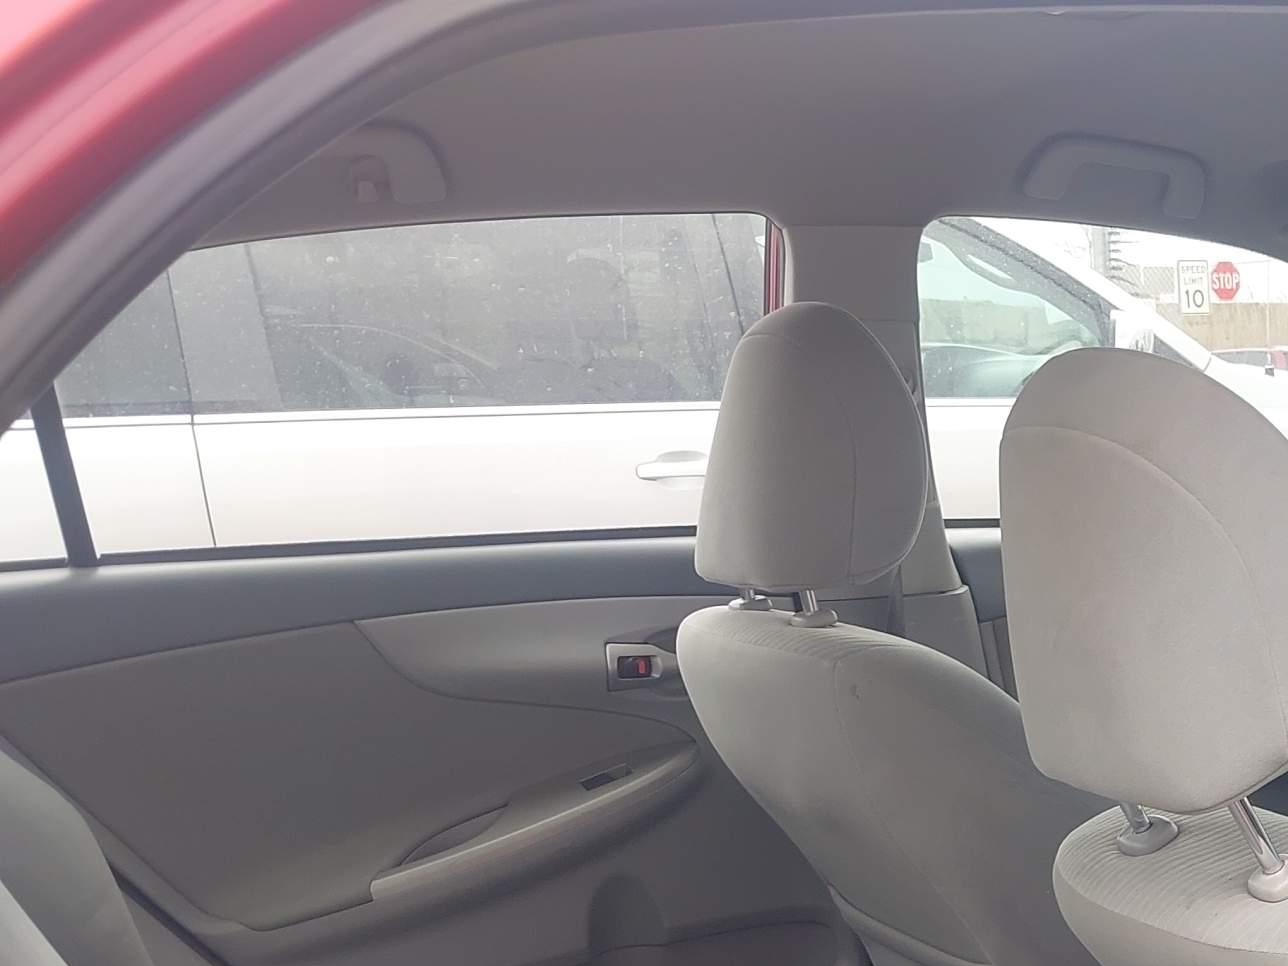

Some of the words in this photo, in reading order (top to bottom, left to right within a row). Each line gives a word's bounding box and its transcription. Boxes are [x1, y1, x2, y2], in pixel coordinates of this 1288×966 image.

[1181, 265, 1206, 274] SPEED
[1184, 277, 1204, 286] LIMIT
[1212, 272, 1240, 290] STOP
[1185, 289, 1205, 309] 10
